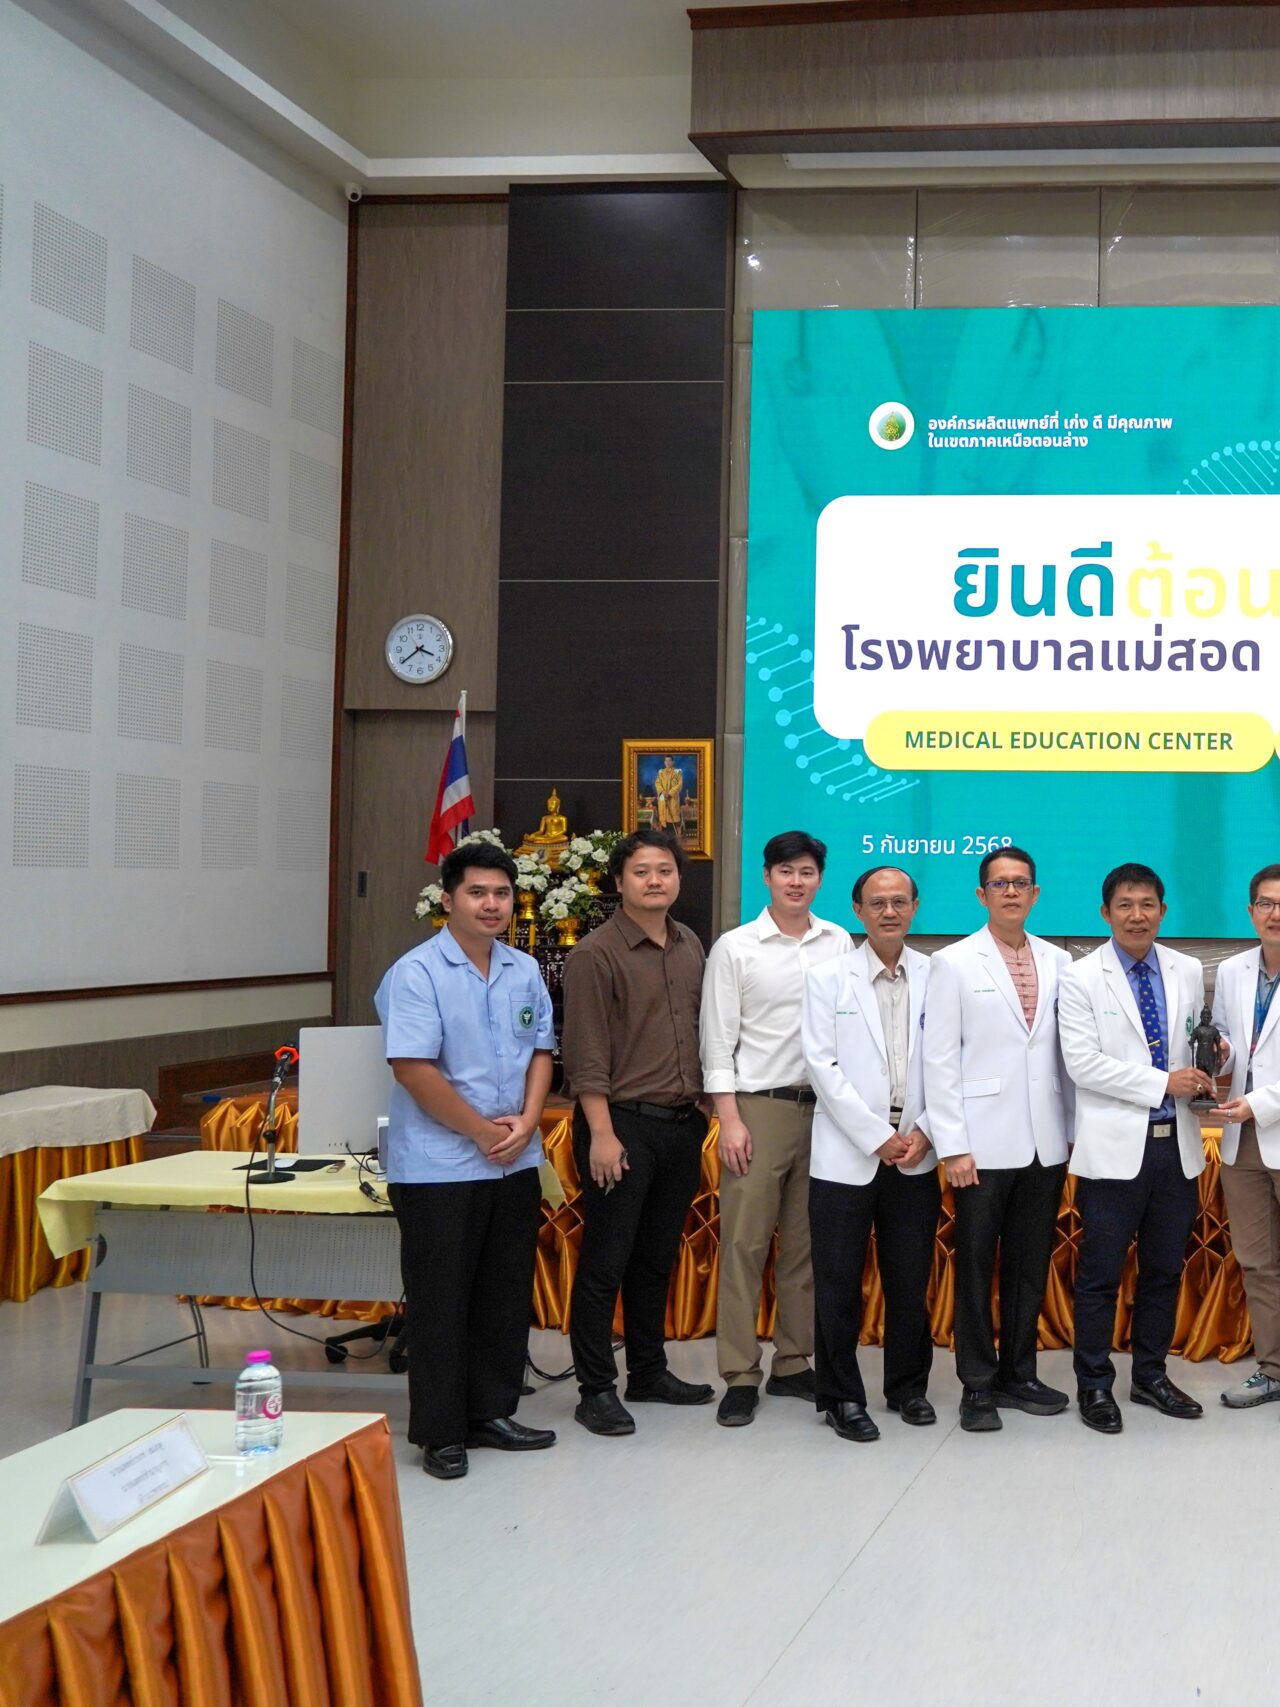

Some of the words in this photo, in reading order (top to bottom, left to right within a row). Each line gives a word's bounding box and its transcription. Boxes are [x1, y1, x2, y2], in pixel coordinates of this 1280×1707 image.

[928, 411, 1059, 430] องค์กรผลิตแพทย์ที่
[1063, 413, 1089, 430] เก่ง
[1092, 414, 1103, 430] ดี
[1107, 414, 1173, 433] มีคุณภาพ
[928, 431, 1089, 448] ในเขตภาคเหนือตอนล่าง
[841, 623, 1260, 672] โรงพยาบาลแม่สอด
[417, 667, 424, 675] 6
[905, 730, 1003, 749] MEDICAL
[1010, 731, 1140, 750] EDUCATION
[1148, 732, 1233, 751] CENTER
[862, 834, 874, 854] 5
[880, 833, 955, 854] กันยายน
